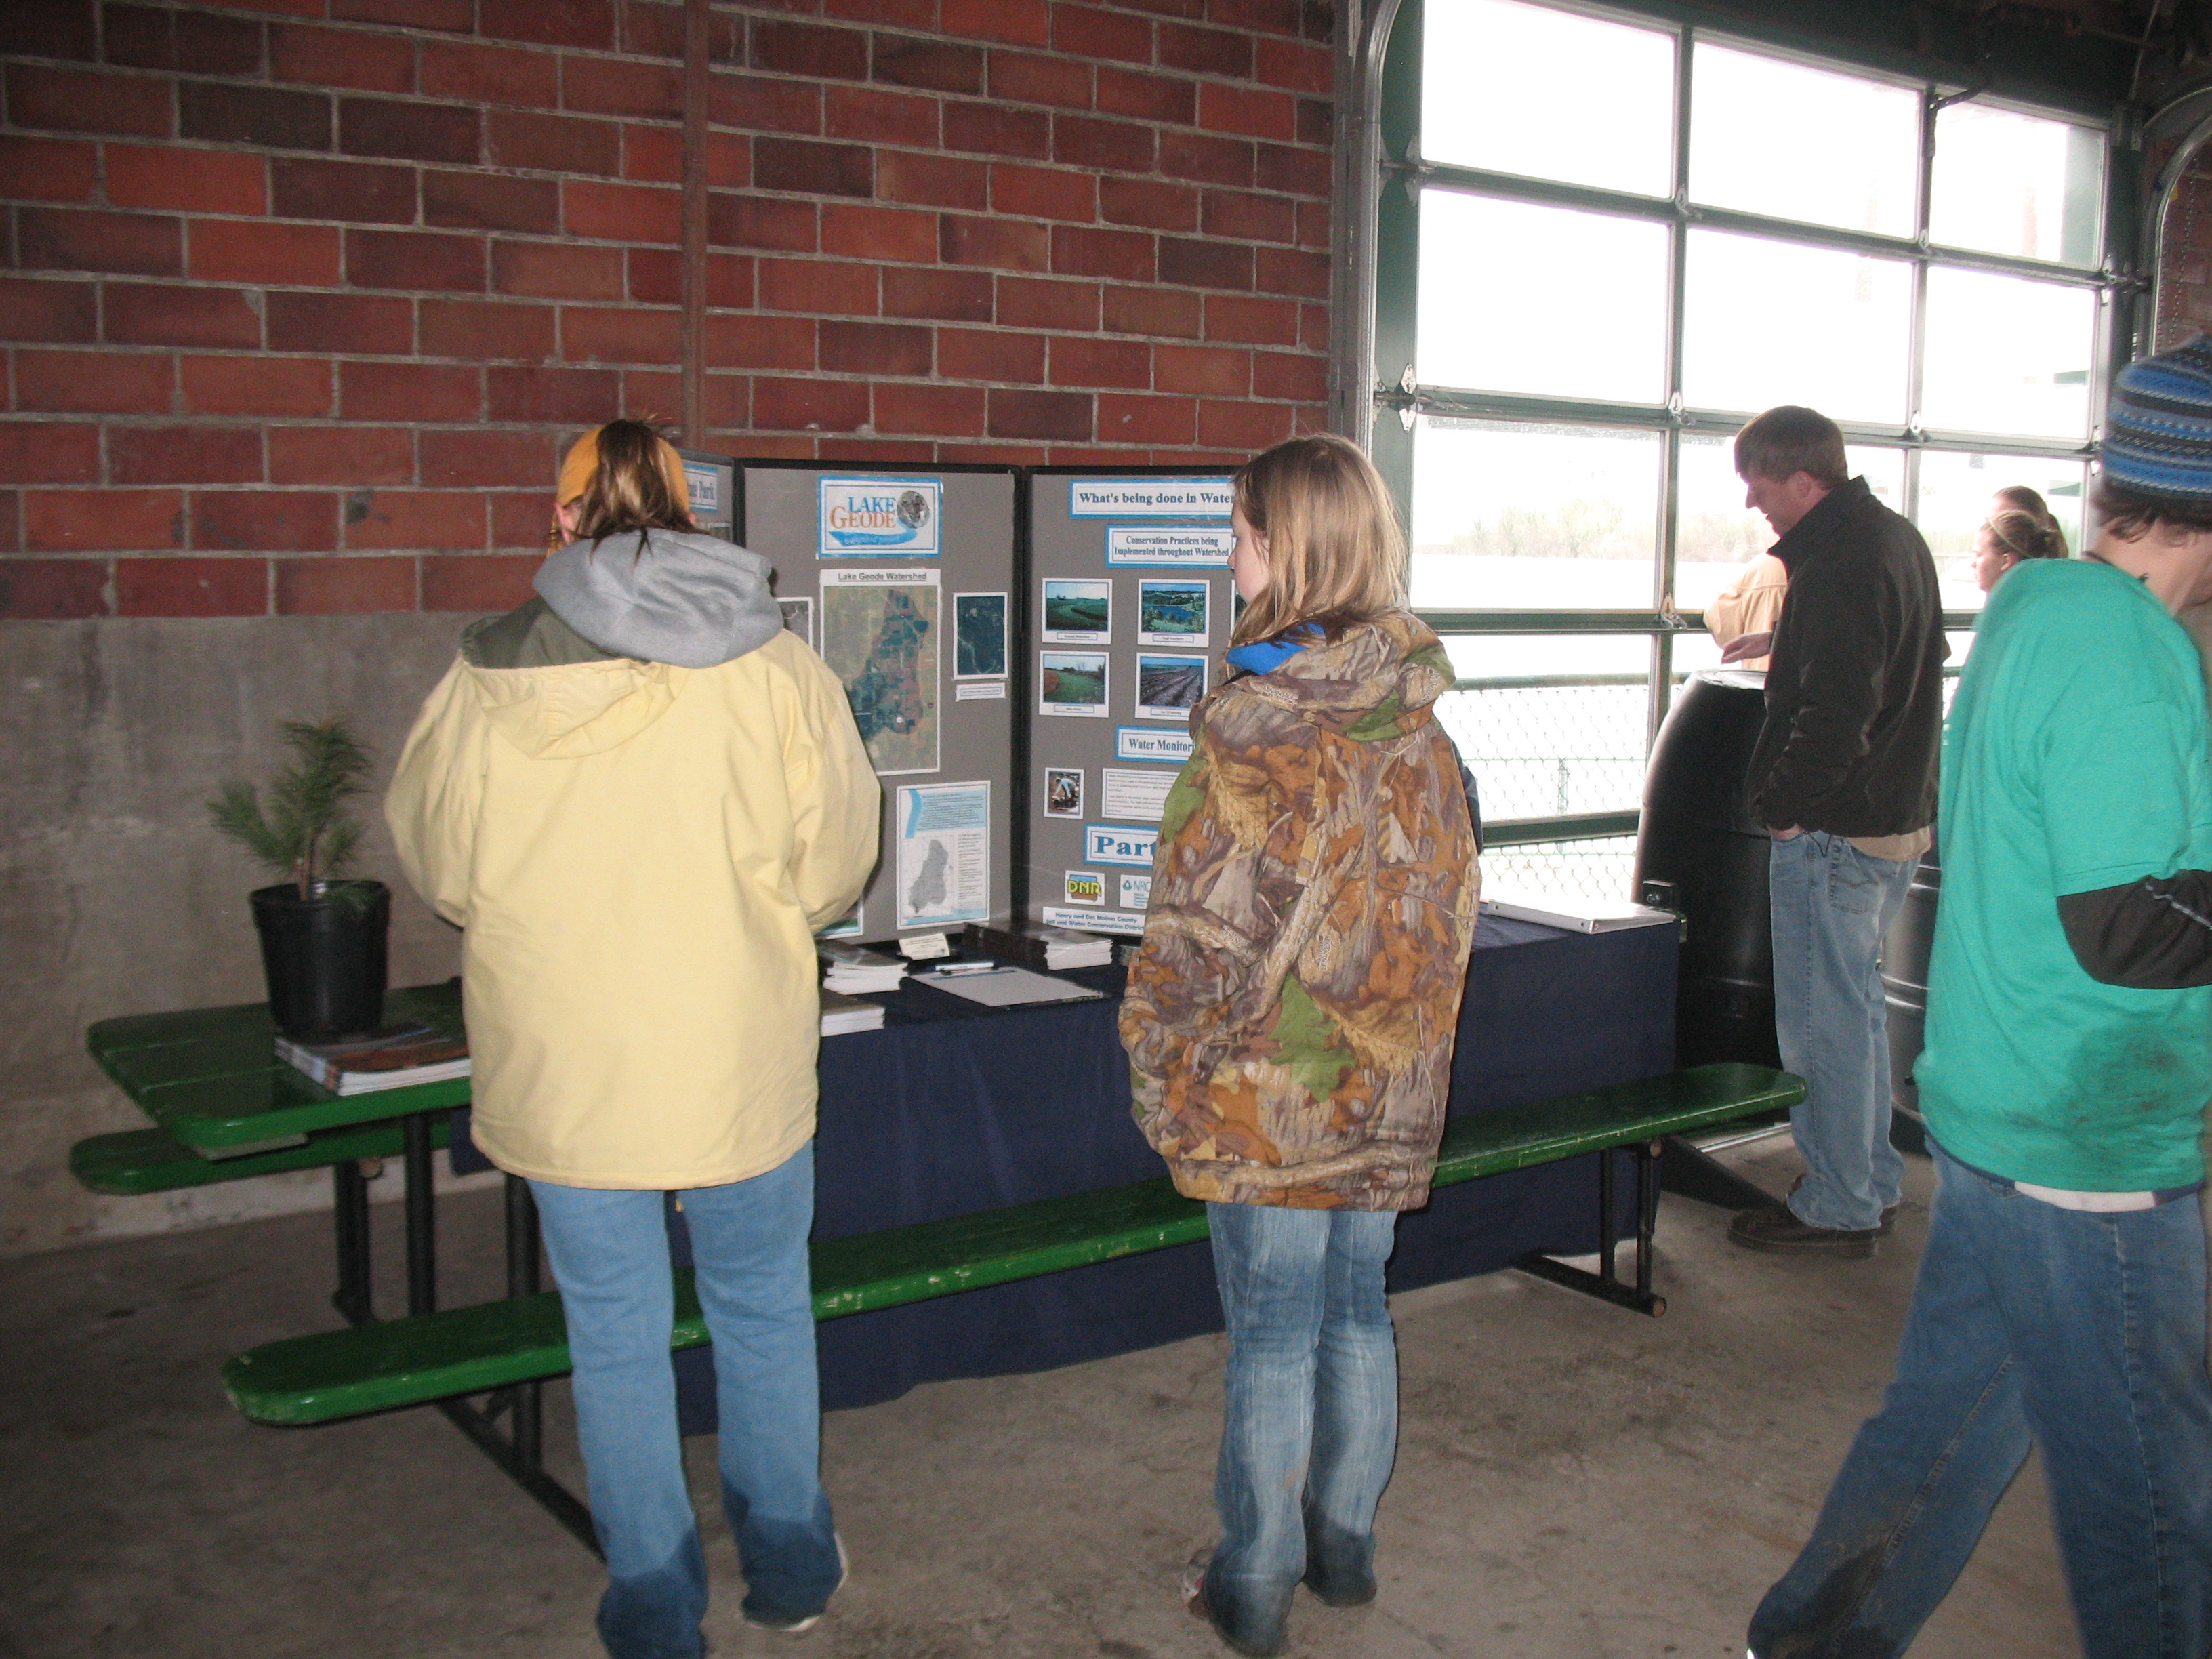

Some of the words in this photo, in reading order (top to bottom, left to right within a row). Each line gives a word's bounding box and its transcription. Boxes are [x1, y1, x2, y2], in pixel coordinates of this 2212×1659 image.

[848, 497, 896, 512] LAKE
[1079, 493, 1119, 504] What's
[1122, 493, 1153, 505] being
[1156, 493, 1183, 504] done
[1187, 493, 1197, 504] in
[1200, 493, 1235, 504] Water
[830, 506, 896, 529] GEODE
[1126, 535, 1168, 545] Conservation
[1170, 536, 1200, 545] Practices
[1201, 537, 1218, 546] being
[1114, 546, 1155, 557] Implemented
[1157, 548, 1193, 558] throughout
[1195, 548, 1229, 556] Watershed
[838, 572, 857, 581] Lake
[859, 572, 884, 581] Geode
[886, 572, 927, 581] Watershed
[1128, 738, 1155, 750] Water
[1094, 836, 1157, 856] Part
[1068, 880, 1101, 896] DNR
